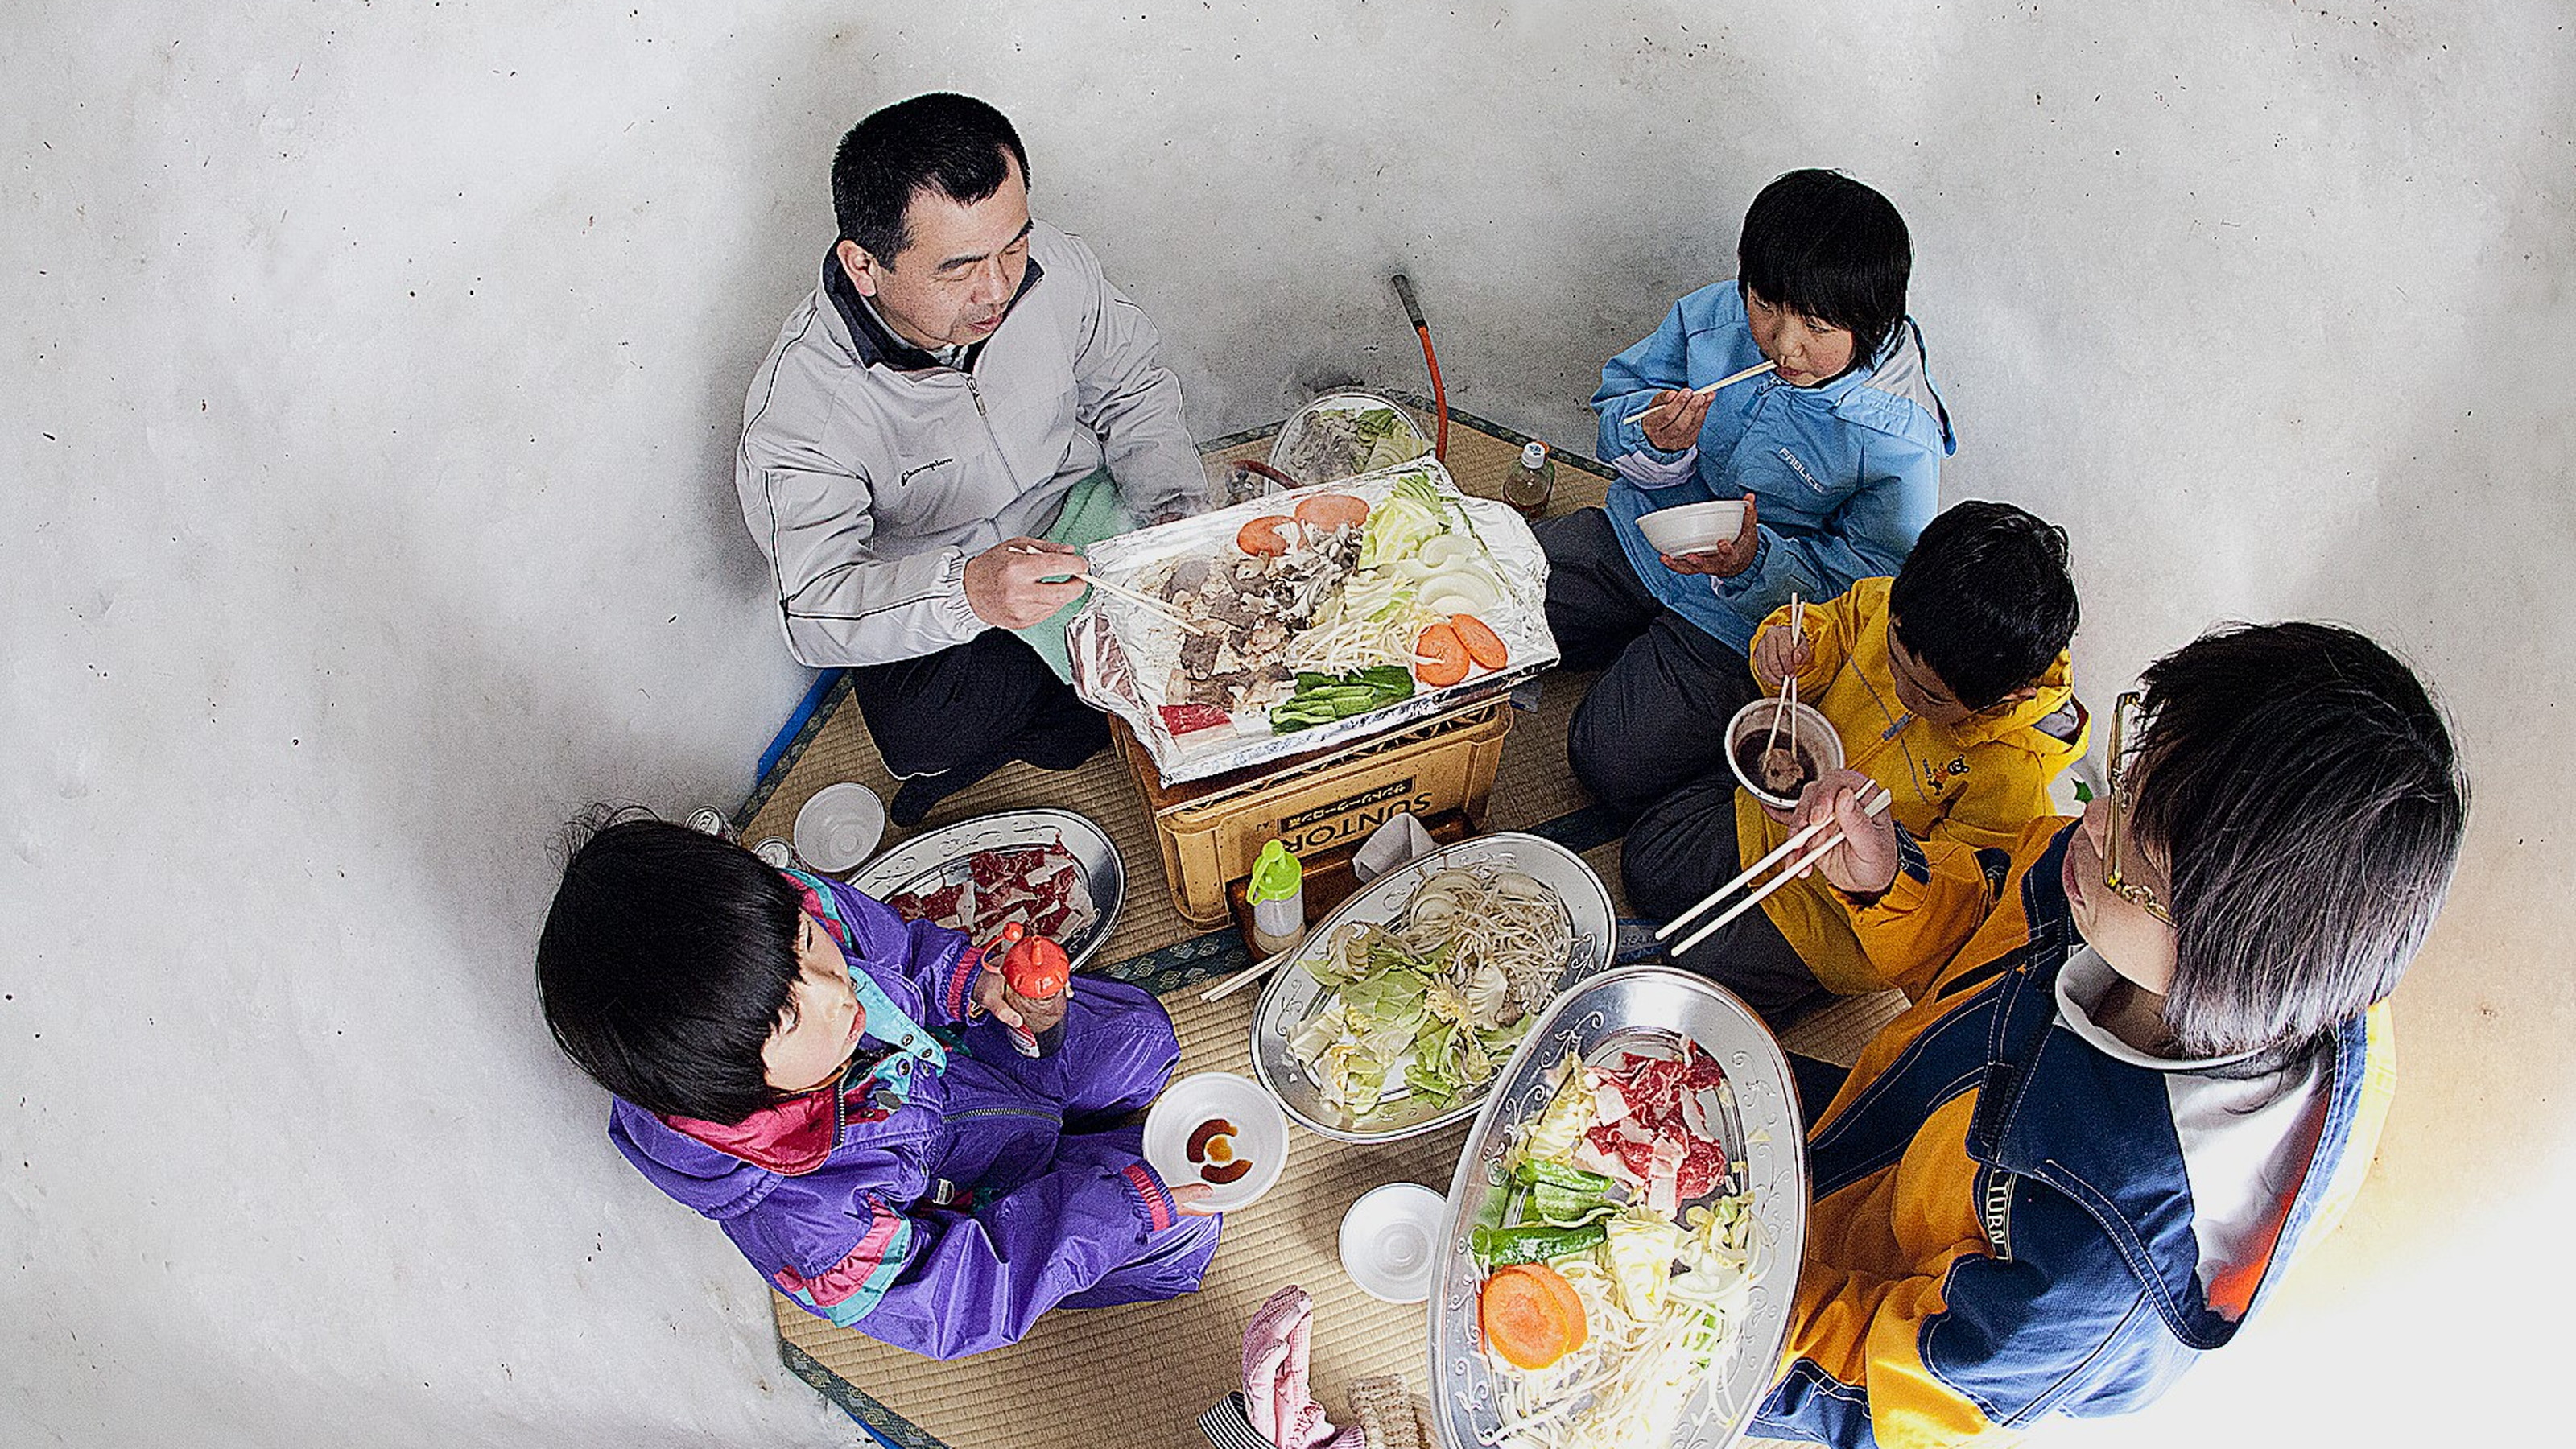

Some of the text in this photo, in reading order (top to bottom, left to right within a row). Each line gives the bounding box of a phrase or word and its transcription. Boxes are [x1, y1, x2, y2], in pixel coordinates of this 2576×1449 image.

[1282, 792, 1433, 853] SUNTOR
[1288, 782, 1407, 827] サントリーウーロン茶
[1987, 1180, 2009, 1245] TURN
